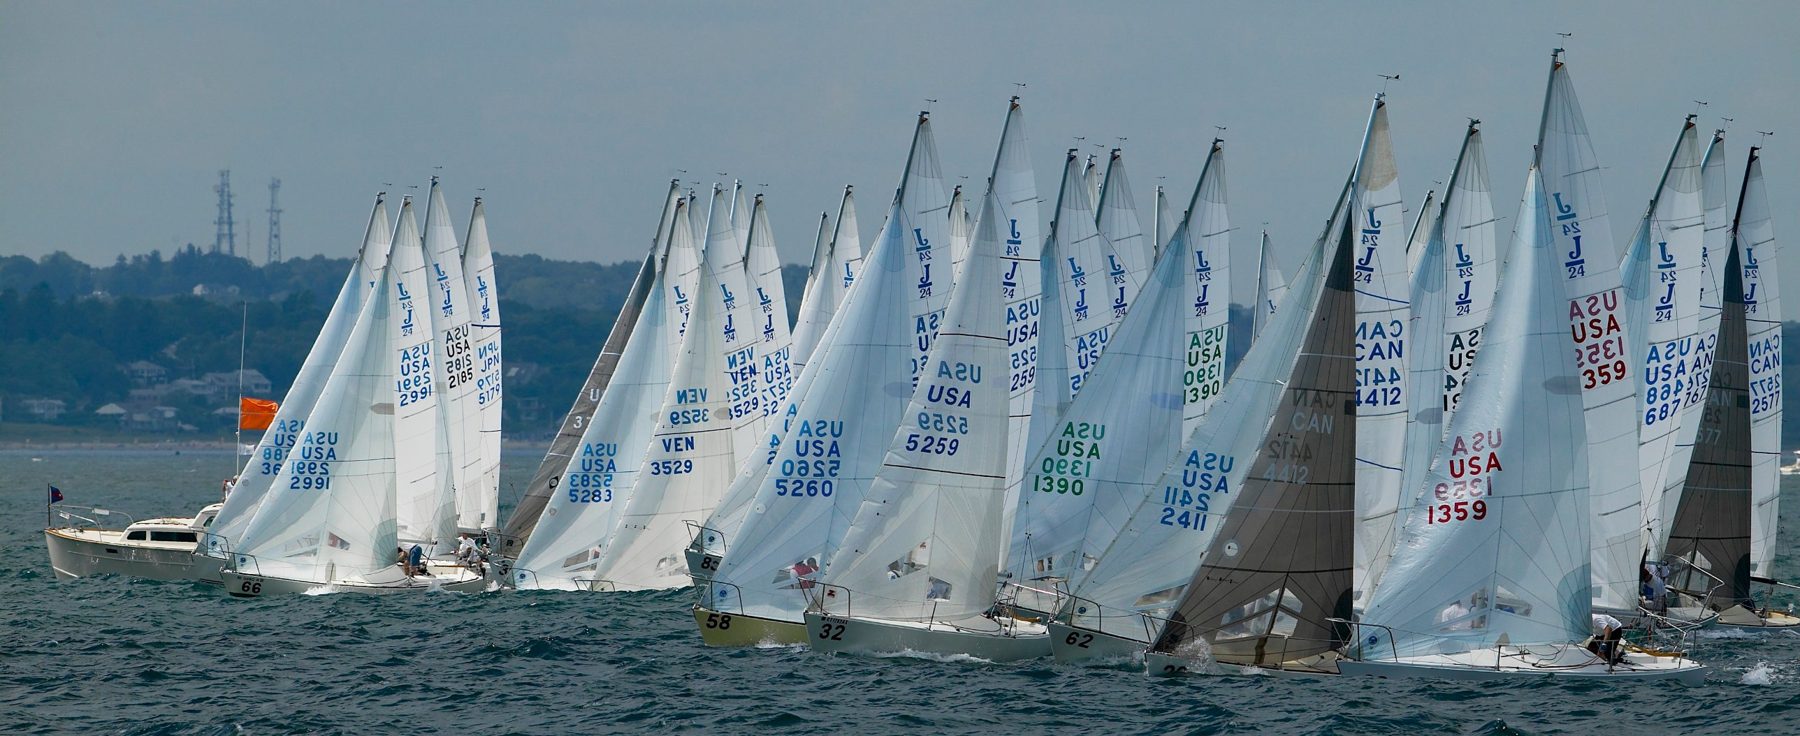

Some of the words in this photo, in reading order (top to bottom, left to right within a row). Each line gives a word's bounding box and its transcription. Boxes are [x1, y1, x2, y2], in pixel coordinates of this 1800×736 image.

[1357, 247, 1376, 266] J
[1568, 235, 1582, 259] J
[920, 264, 931, 283] J
[1004, 261, 1019, 280] J
[1354, 270, 1372, 284] 24
[444, 290, 451, 305] J
[1076, 288, 1086, 307] J
[1114, 286, 1125, 304] J
[1196, 284, 1209, 302] J
[1457, 280, 1471, 300] J
[1660, 283, 1675, 303] J
[1745, 283, 1756, 300] J
[482, 298, 488, 310] J
[404, 309, 412, 324] J
[724, 314, 733, 330] J
[765, 313, 773, 330] J
[1008, 320, 1038, 347] USA
[1571, 313, 1621, 343] USA
[446, 339, 470, 358] USA
[1188, 344, 1222, 367] USA
[1355, 340, 1403, 362] CAN
[401, 357, 430, 376] USA
[481, 353, 500, 373] JPN
[1646, 359, 1686, 385] USA
[1751, 351, 1780, 374] CAN
[448, 367, 473, 389] 2185
[730, 362, 758, 385] VEN
[765, 362, 791, 384] USA
[1582, 360, 1626, 389] 359
[400, 384, 432, 407] 2991
[479, 383, 500, 404] 5179
[927, 384, 971, 409] USA
[1183, 380, 1220, 405] 1390
[1751, 390, 1780, 414] 2577
[1292, 412, 1334, 435] CAN
[302, 446, 337, 460] USA
[662, 436, 695, 453] VEN
[796, 439, 841, 458] USA
[905, 433, 960, 456] 5259
[1057, 439, 1101, 460] USA
[582, 459, 617, 473] USA
[651, 459, 693, 476] 3529
[1263, 462, 1309, 485] 4412
[1449, 452, 1503, 478] USA
[290, 476, 330, 490] 2991
[775, 479, 833, 497] 5260
[1034, 474, 1084, 496] 1390
[1182, 469, 1229, 494] USA
[569, 488, 613, 503] 5283
[1160, 506, 1207, 531] 2411
[1428, 500, 1487, 524] 1359
[241, 581, 262, 594] 66
[705, 613, 732, 630] 58
[819, 623, 846, 641] 32
[1065, 631, 1094, 649] 62
